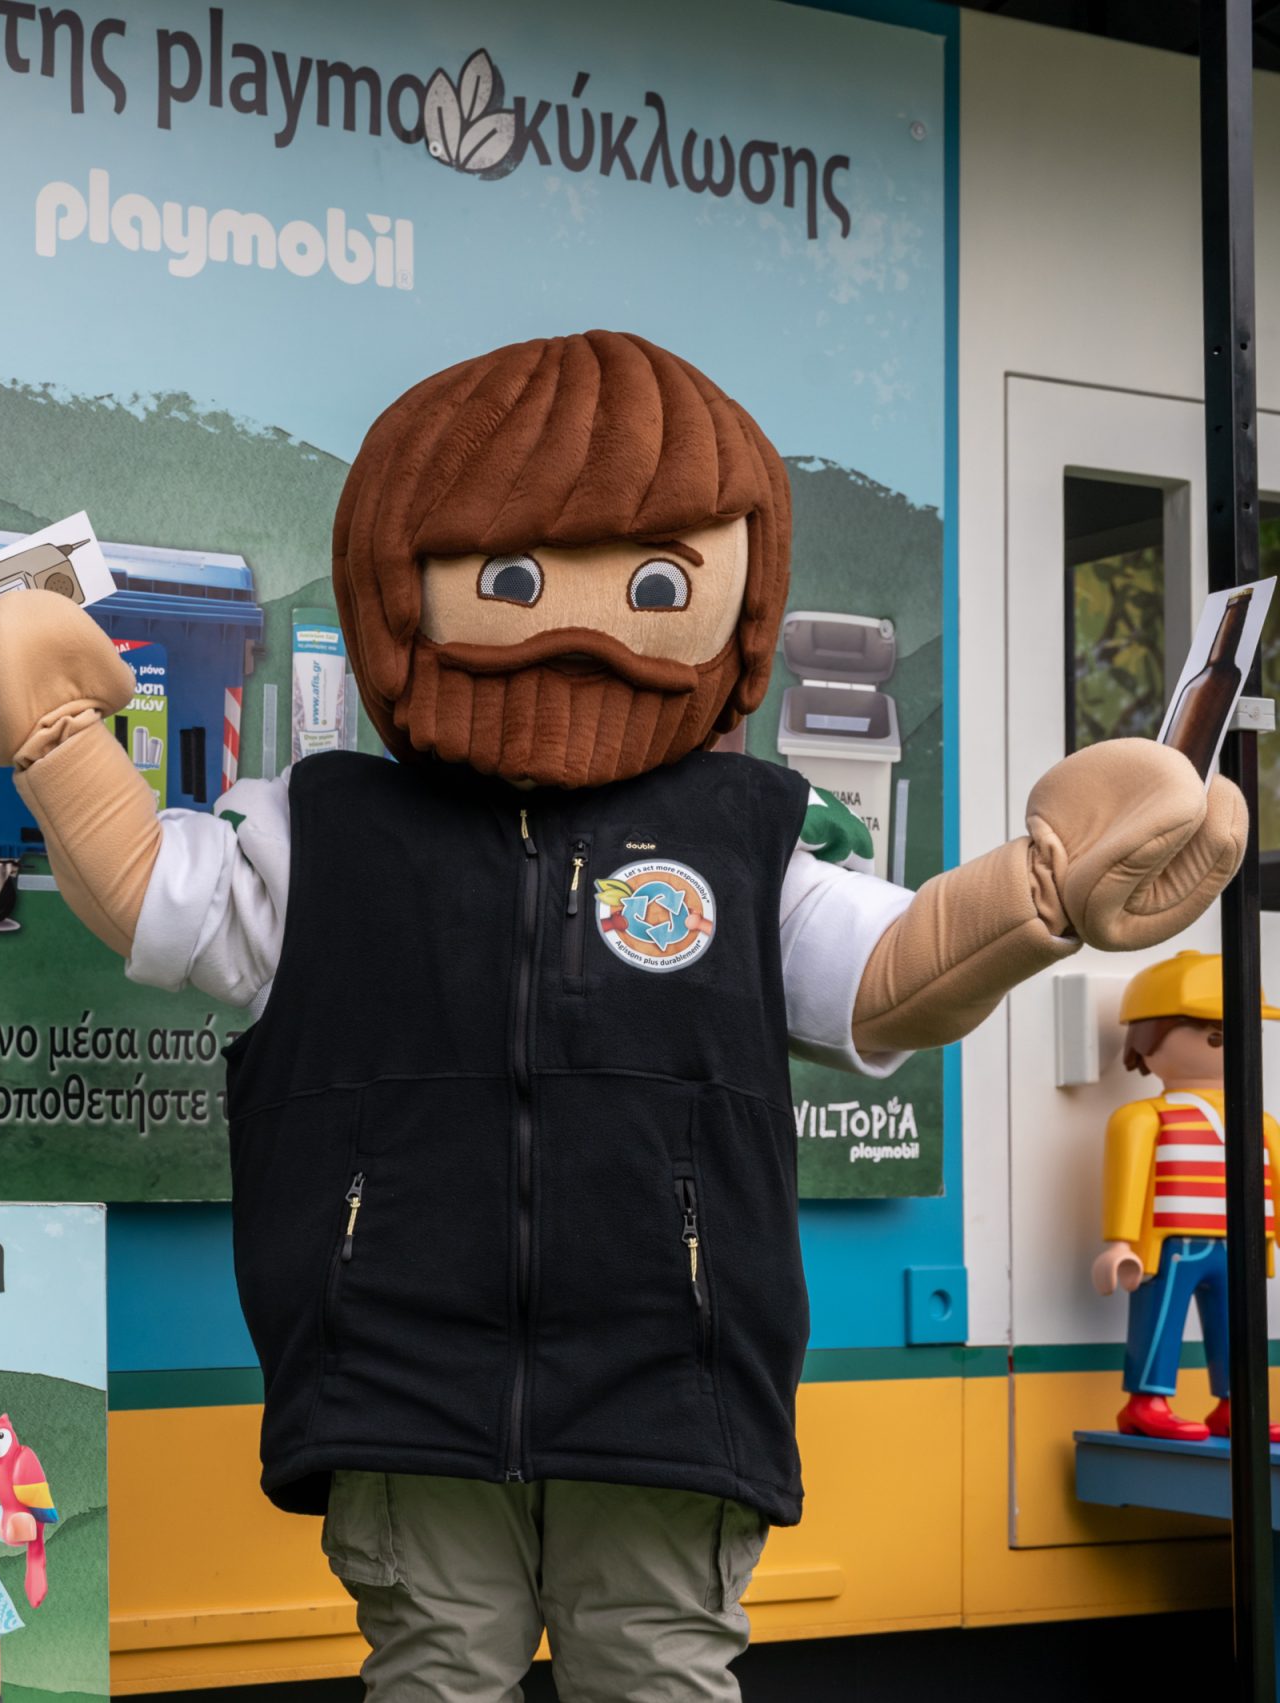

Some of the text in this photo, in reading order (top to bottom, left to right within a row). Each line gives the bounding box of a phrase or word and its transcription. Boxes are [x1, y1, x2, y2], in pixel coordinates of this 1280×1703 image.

[35, 167, 414, 291] playmobil
[312, 660, 322, 726] www.afis.gr
[625, 842, 656, 850] double
[655, 865, 676, 873] more
[615, 940, 642, 962] Agissons
[643, 957, 659, 966] plus
[48, 1010, 139, 1072] μέσα
[147, 1013, 219, 1062] από
[849, 1142, 920, 1163] playmobil
